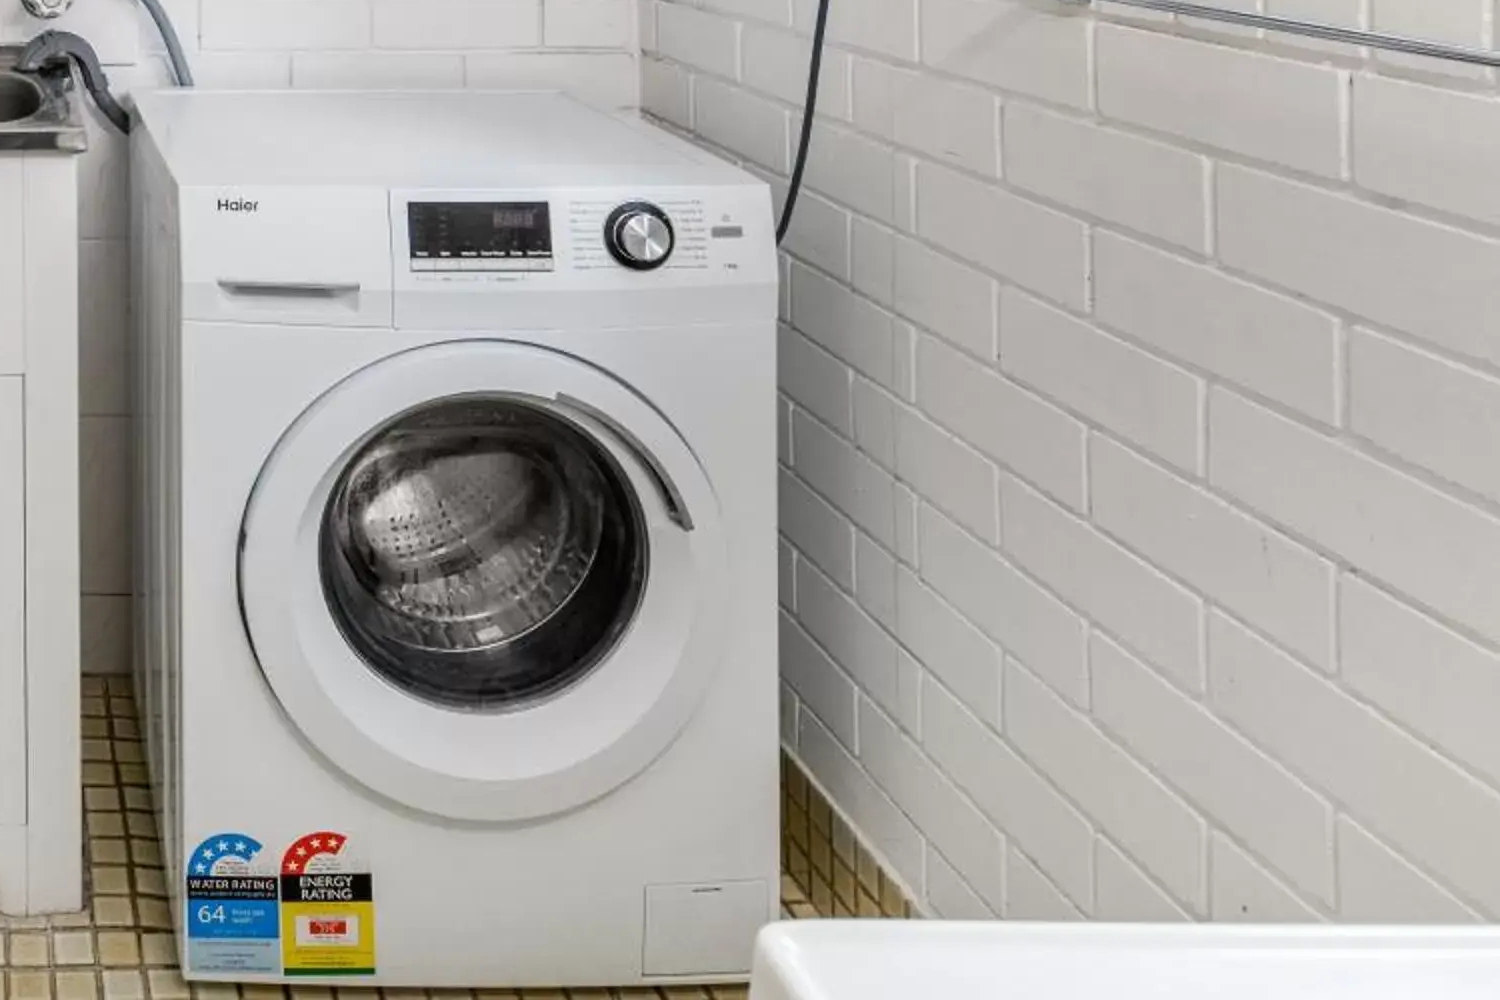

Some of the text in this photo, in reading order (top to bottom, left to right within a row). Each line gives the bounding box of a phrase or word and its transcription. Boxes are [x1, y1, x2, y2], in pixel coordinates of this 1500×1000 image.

[217, 198, 259, 212] Haier
[189, 879, 275, 891] WATER RATING
[299, 875, 353, 888] ENERGY
[301, 887, 353, 900] RATING
[197, 904, 226, 924] 64
